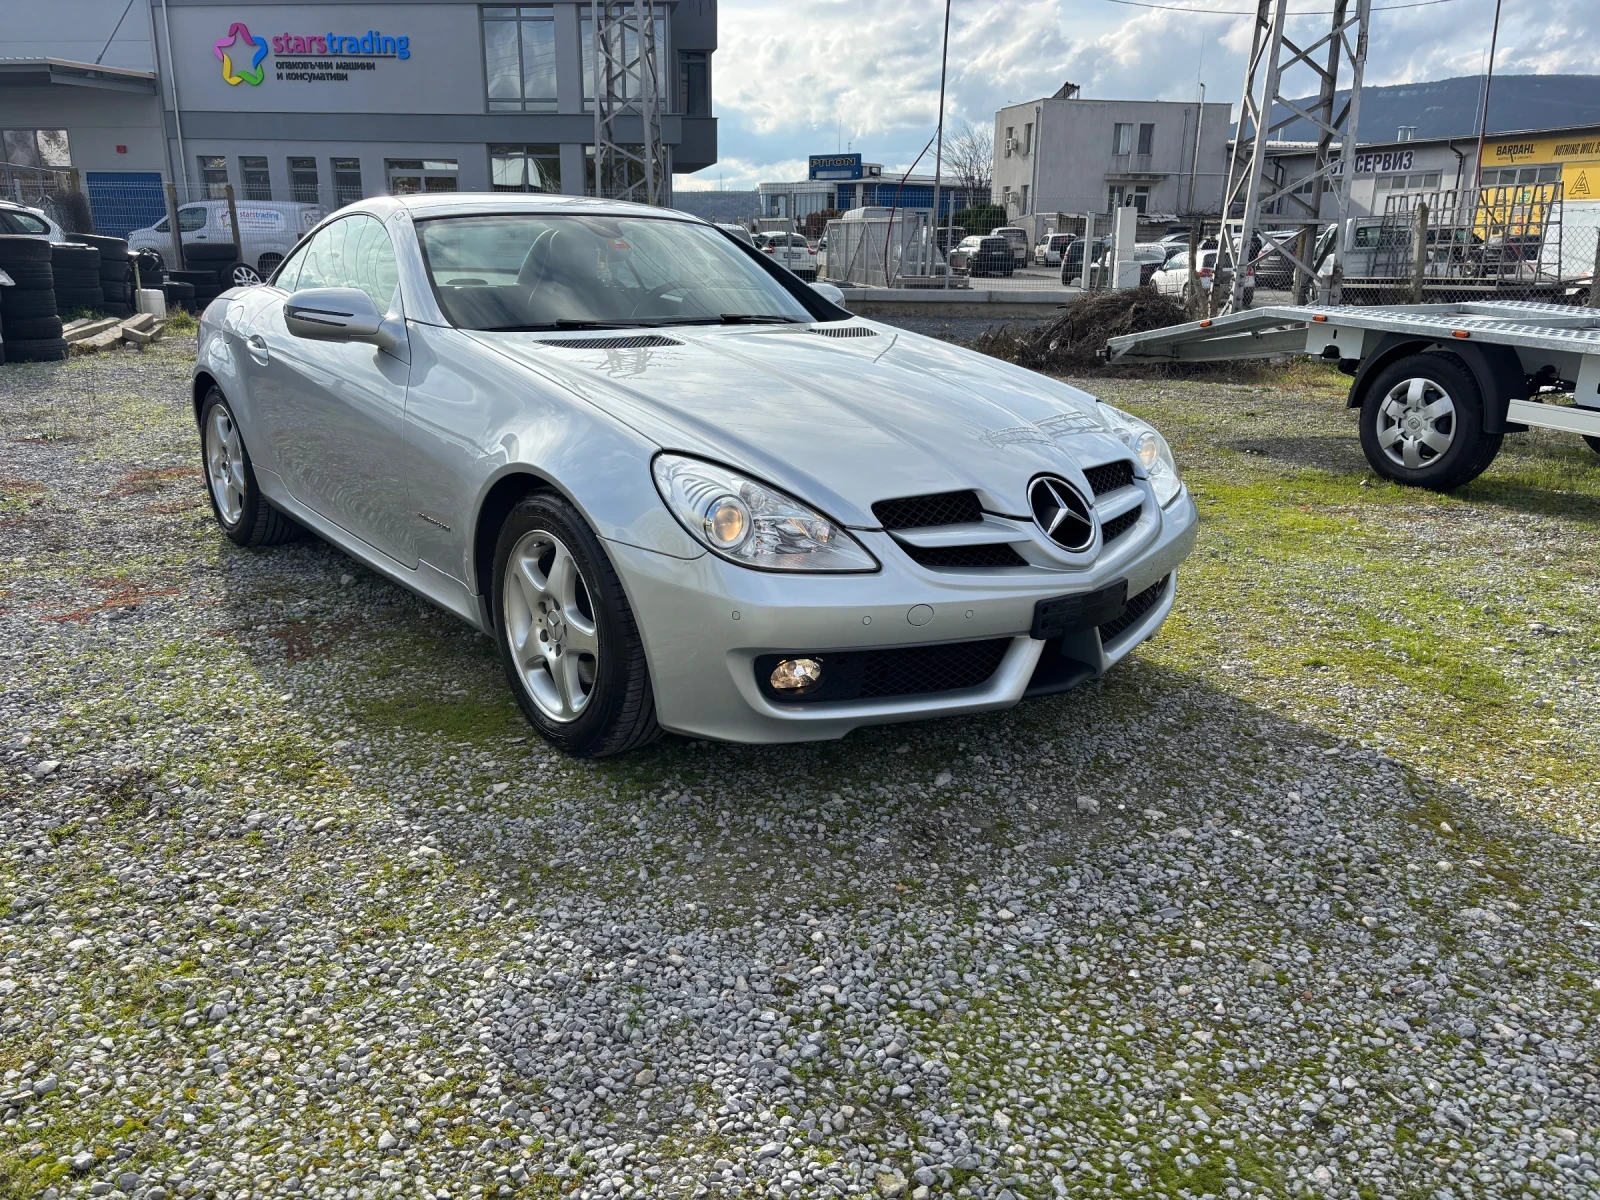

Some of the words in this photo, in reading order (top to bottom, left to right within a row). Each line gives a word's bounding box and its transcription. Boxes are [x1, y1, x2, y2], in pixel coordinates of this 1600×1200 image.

[272, 30, 411, 60] starstrading
[275, 61, 333, 70] опаковъчни
[335, 62, 376, 71] машини
[276, 72, 284, 81] и
[285, 72, 349, 83] консумативи
[1496, 144, 1535, 161] BARDAHL
[1553, 143, 1581, 156] NOTHING
[1579, 142, 1596, 155] WILL
[810, 157, 856, 168] PITON
[240, 211, 279, 221] starstrading
